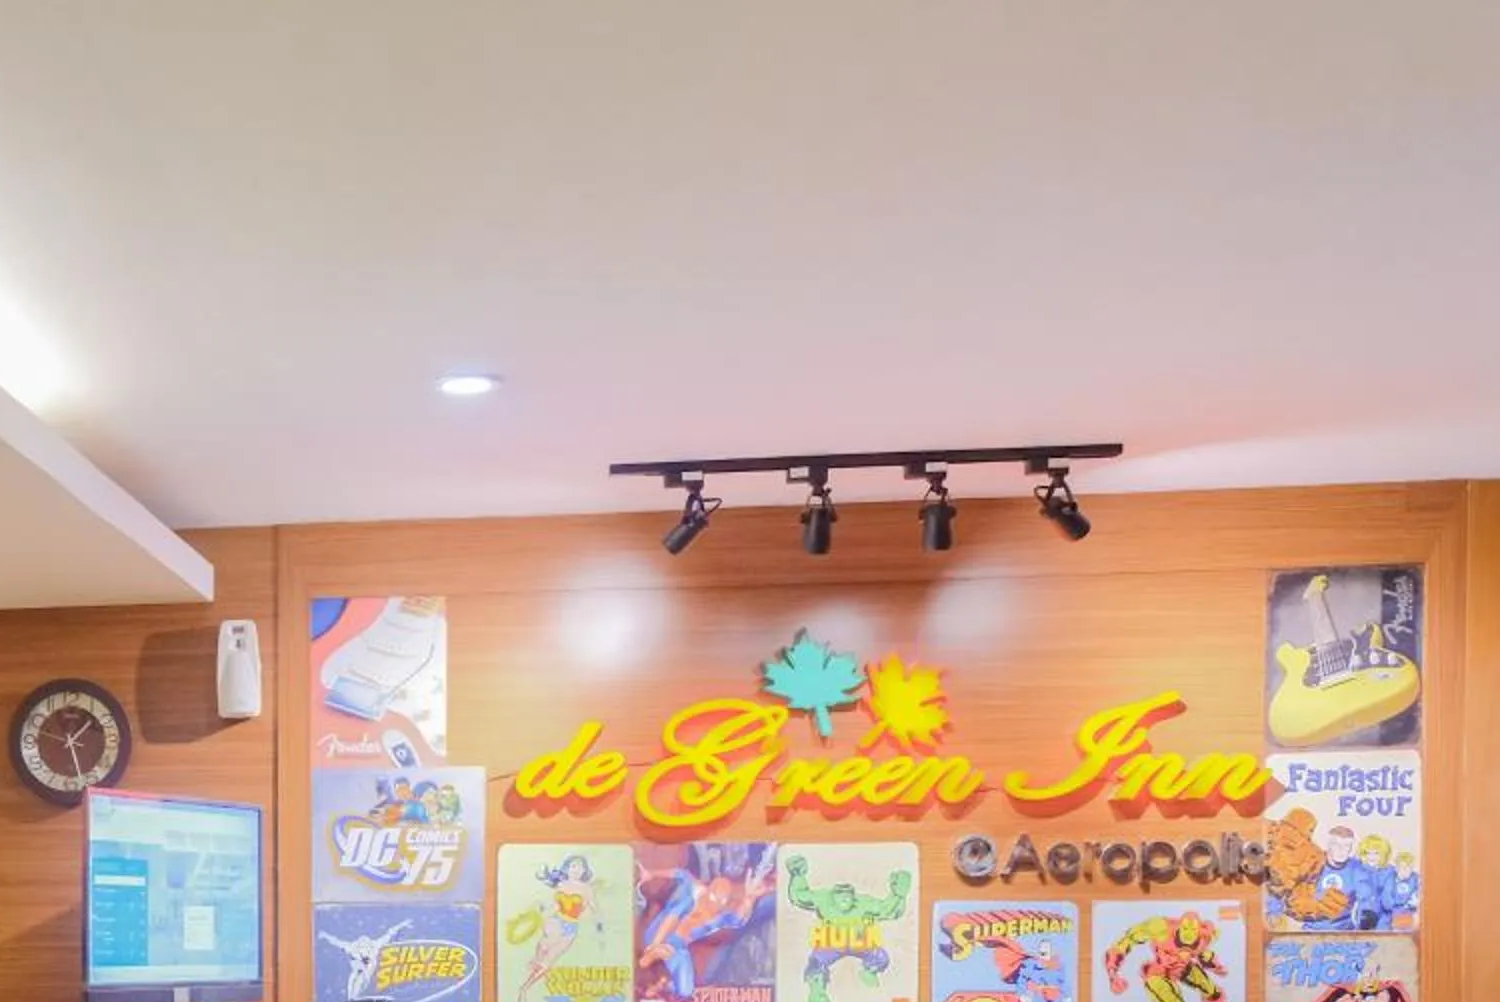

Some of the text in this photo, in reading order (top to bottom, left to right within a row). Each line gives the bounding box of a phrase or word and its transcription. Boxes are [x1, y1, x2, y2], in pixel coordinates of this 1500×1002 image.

[514, 688, 1273, 827] de Green Inn
[339, 826, 401, 868] DC
[400, 845, 459, 885] 75
[379, 945, 467, 968] SILVER
[946, 912, 1073, 961] SUPERMAN
[376, 962, 466, 992] SURFER
